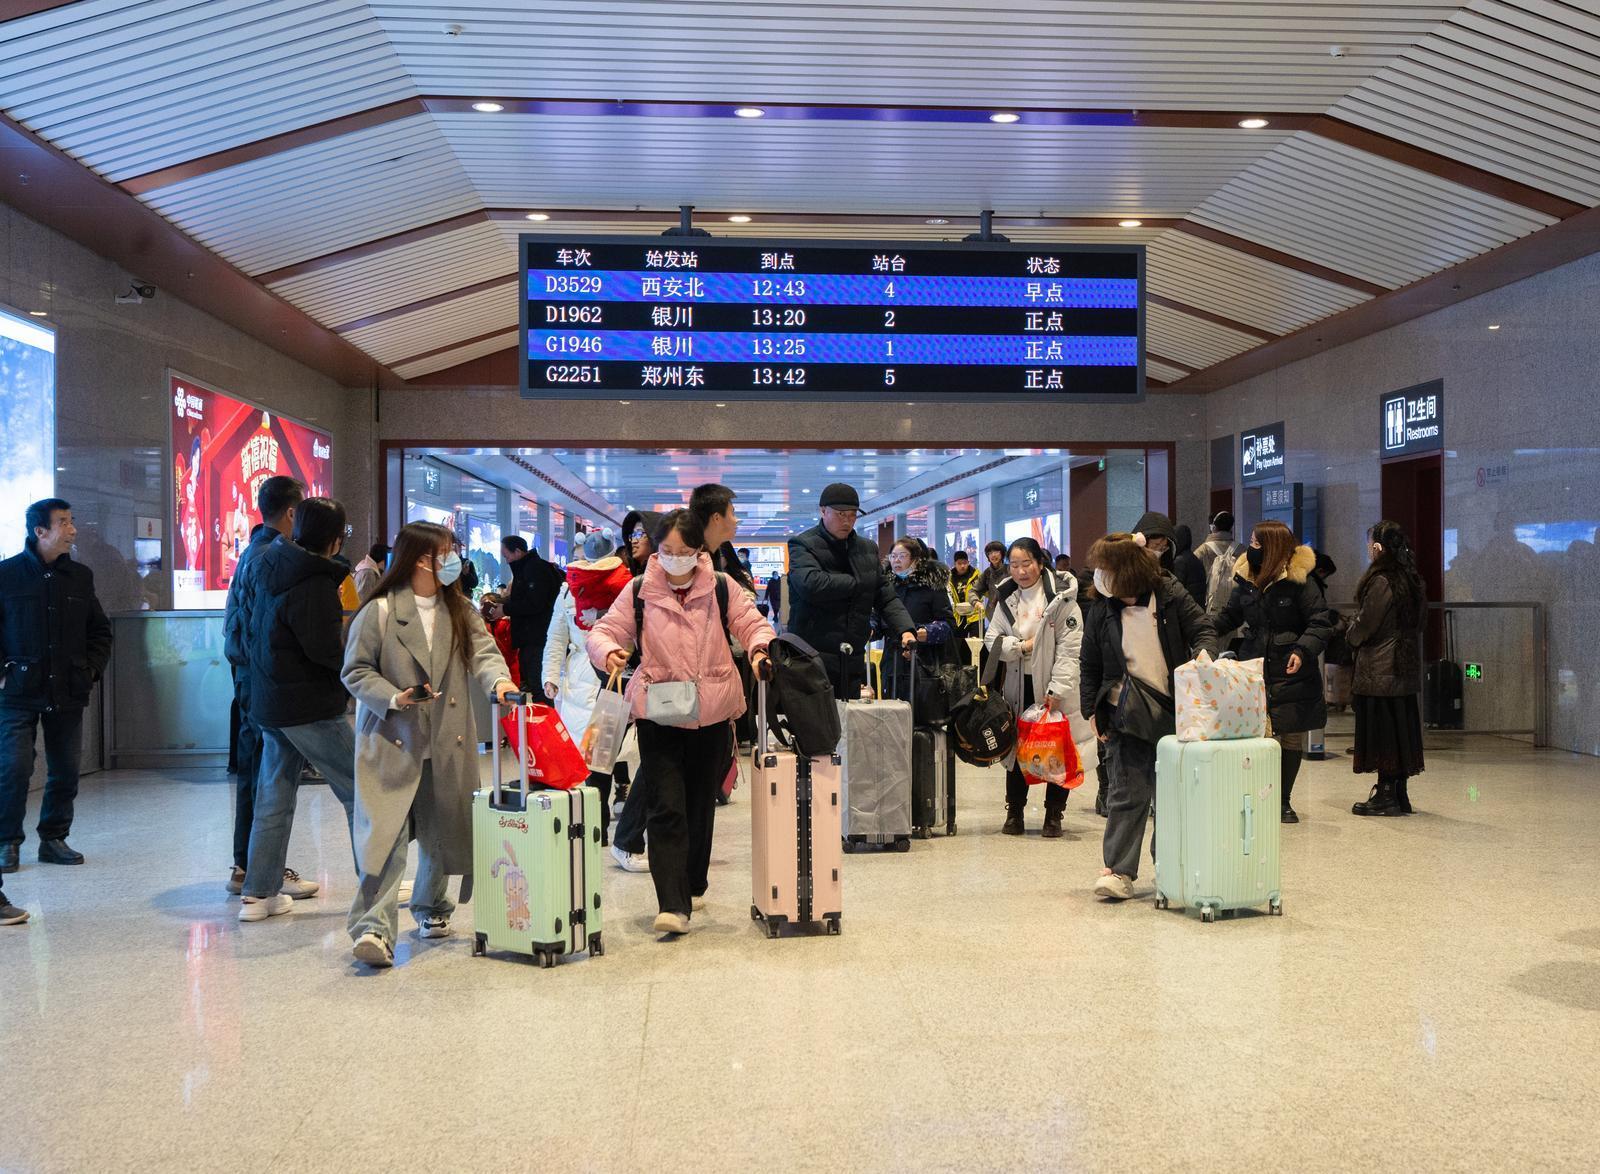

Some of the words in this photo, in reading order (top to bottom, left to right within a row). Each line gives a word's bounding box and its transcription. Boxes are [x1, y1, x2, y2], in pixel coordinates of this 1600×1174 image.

[555, 248, 593, 268] 车次
[644, 249, 699, 270] 始发站
[760, 251, 796, 271] 到点
[871, 253, 907, 273] 站台
[1025, 255, 1062, 275] 状态
[545, 275, 603, 294] D3529
[640, 276, 706, 299] 西安北
[752, 279, 806, 298] 12:43
[883, 281, 896, 298] 4
[1023, 282, 1065, 304] 早点
[545, 305, 603, 324] D1962
[650, 306, 693, 328] 银川
[752, 309, 806, 327] 13:20
[883, 310, 896, 327] 2
[1023, 311, 1065, 333] 正点
[545, 335, 603, 354] G1946
[650, 335, 693, 358] 银川
[752, 338, 806, 356] 13:25
[885, 340, 895, 356] 1
[1023, 340, 1065, 362] 正点
[545, 365, 603, 384] G2251
[640, 365, 706, 388] 郑州东
[752, 368, 806, 386] 13:42
[884, 369, 896, 385] 5
[1023, 369, 1065, 390] 正点
[1406, 395, 1437, 423] 卫生间
[1256, 434, 1276, 457] 补票处
[1406, 425, 1439, 441] Restrooms
